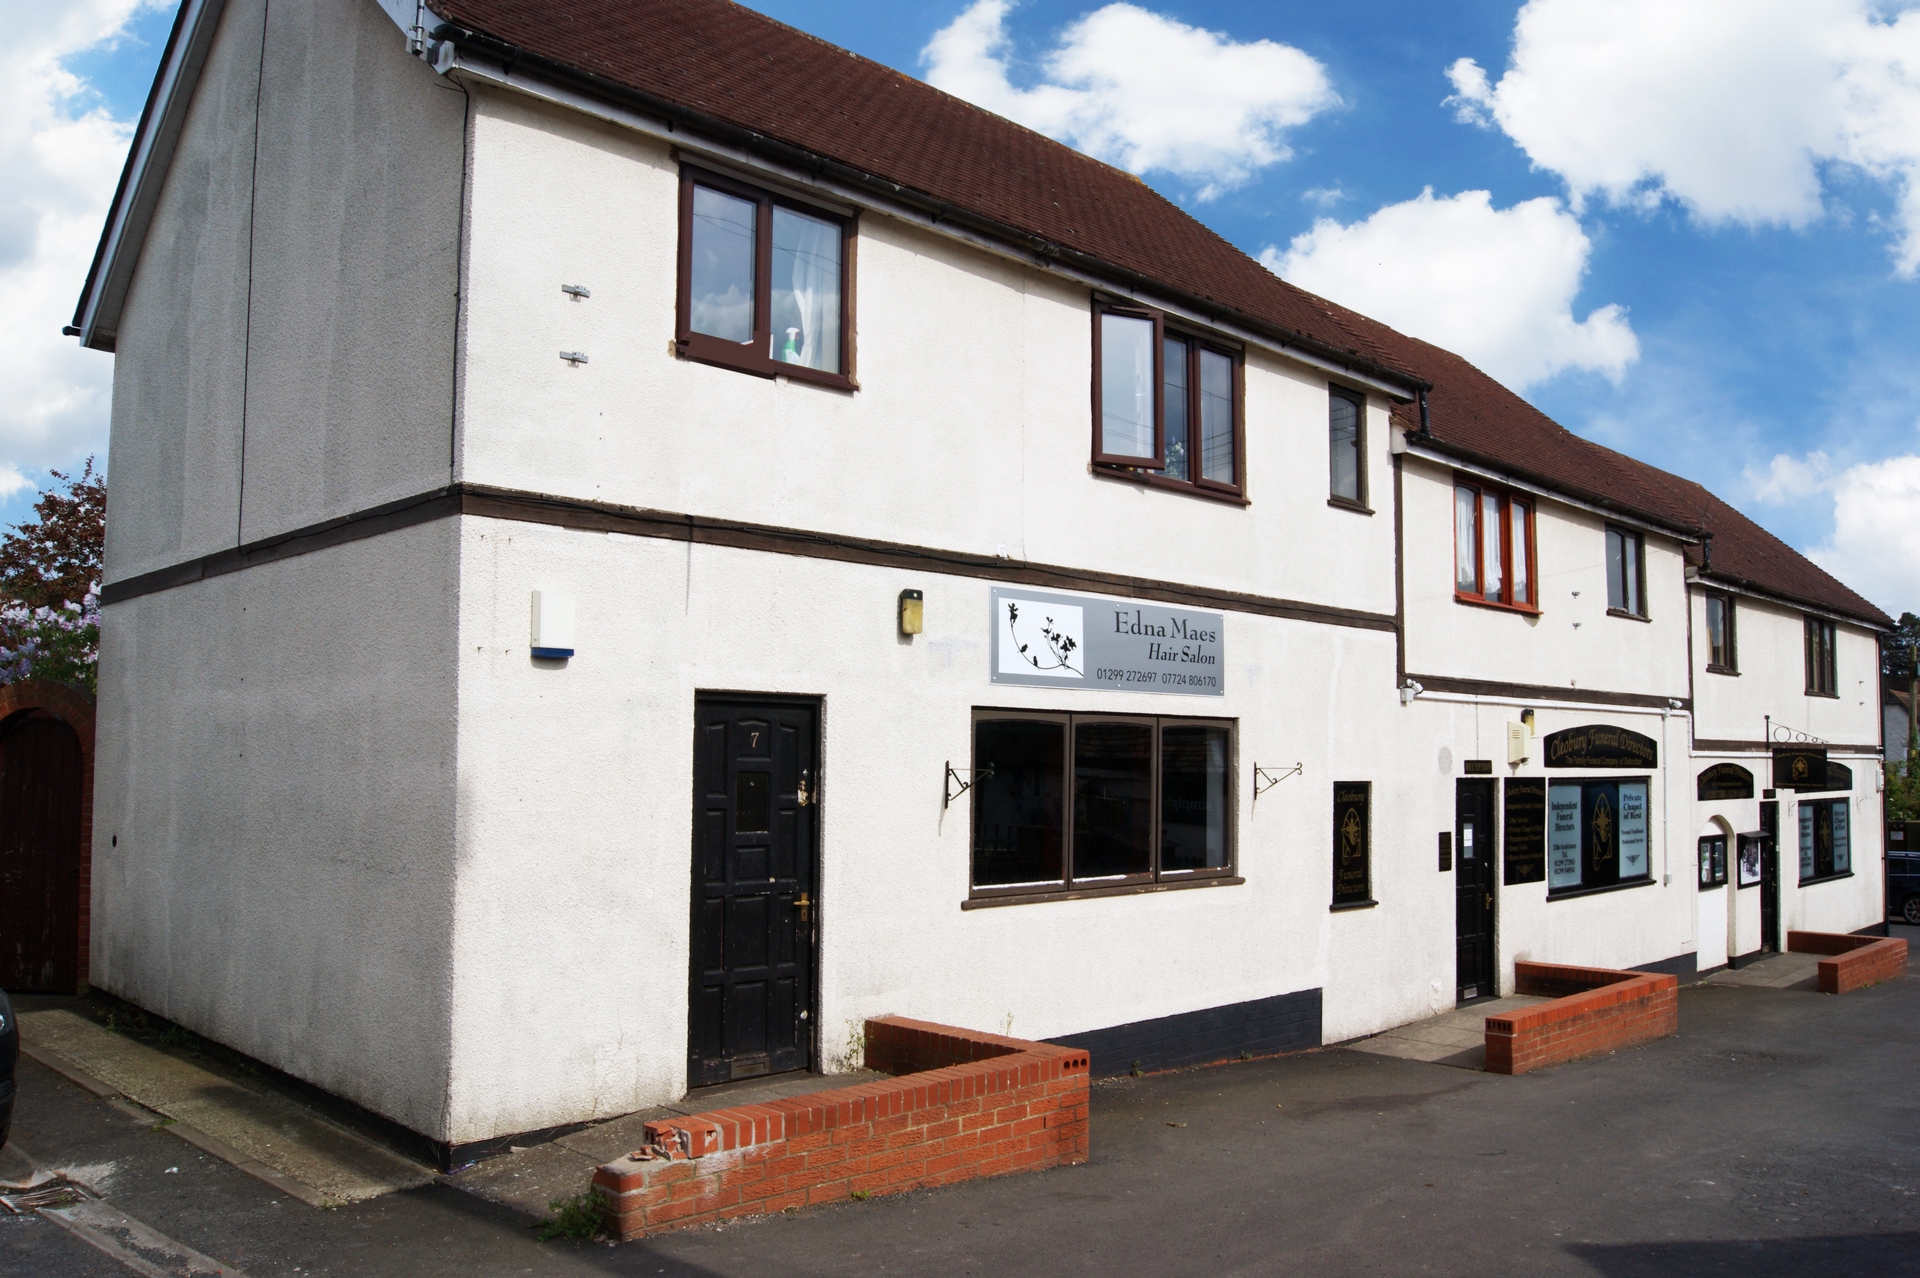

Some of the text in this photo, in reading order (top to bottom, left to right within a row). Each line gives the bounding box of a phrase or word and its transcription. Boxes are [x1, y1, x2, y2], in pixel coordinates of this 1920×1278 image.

[1114, 610, 1216, 642] Edna Maes
[1148, 642, 1216, 664] Hair Salon
[1097, 668, 1216, 687] 01299 272697 07724 806170
[750, 732, 760, 748] 7
[1550, 728, 1654, 760] Cleobury Funeral Directors
[1466, 762, 1491, 771] RECEPTION
[1338, 790, 1365, 806] Cleobury
[1623, 794, 1642, 802] Private
[1552, 802, 1578, 812] Independent
[1623, 803, 1642, 812] Chapel
[1556, 812, 1573, 821] Funeral
[1555, 823, 1575, 832] Directors
[1338, 866, 1363, 882] Funeral
[1336, 882, 1365, 895] Directors
